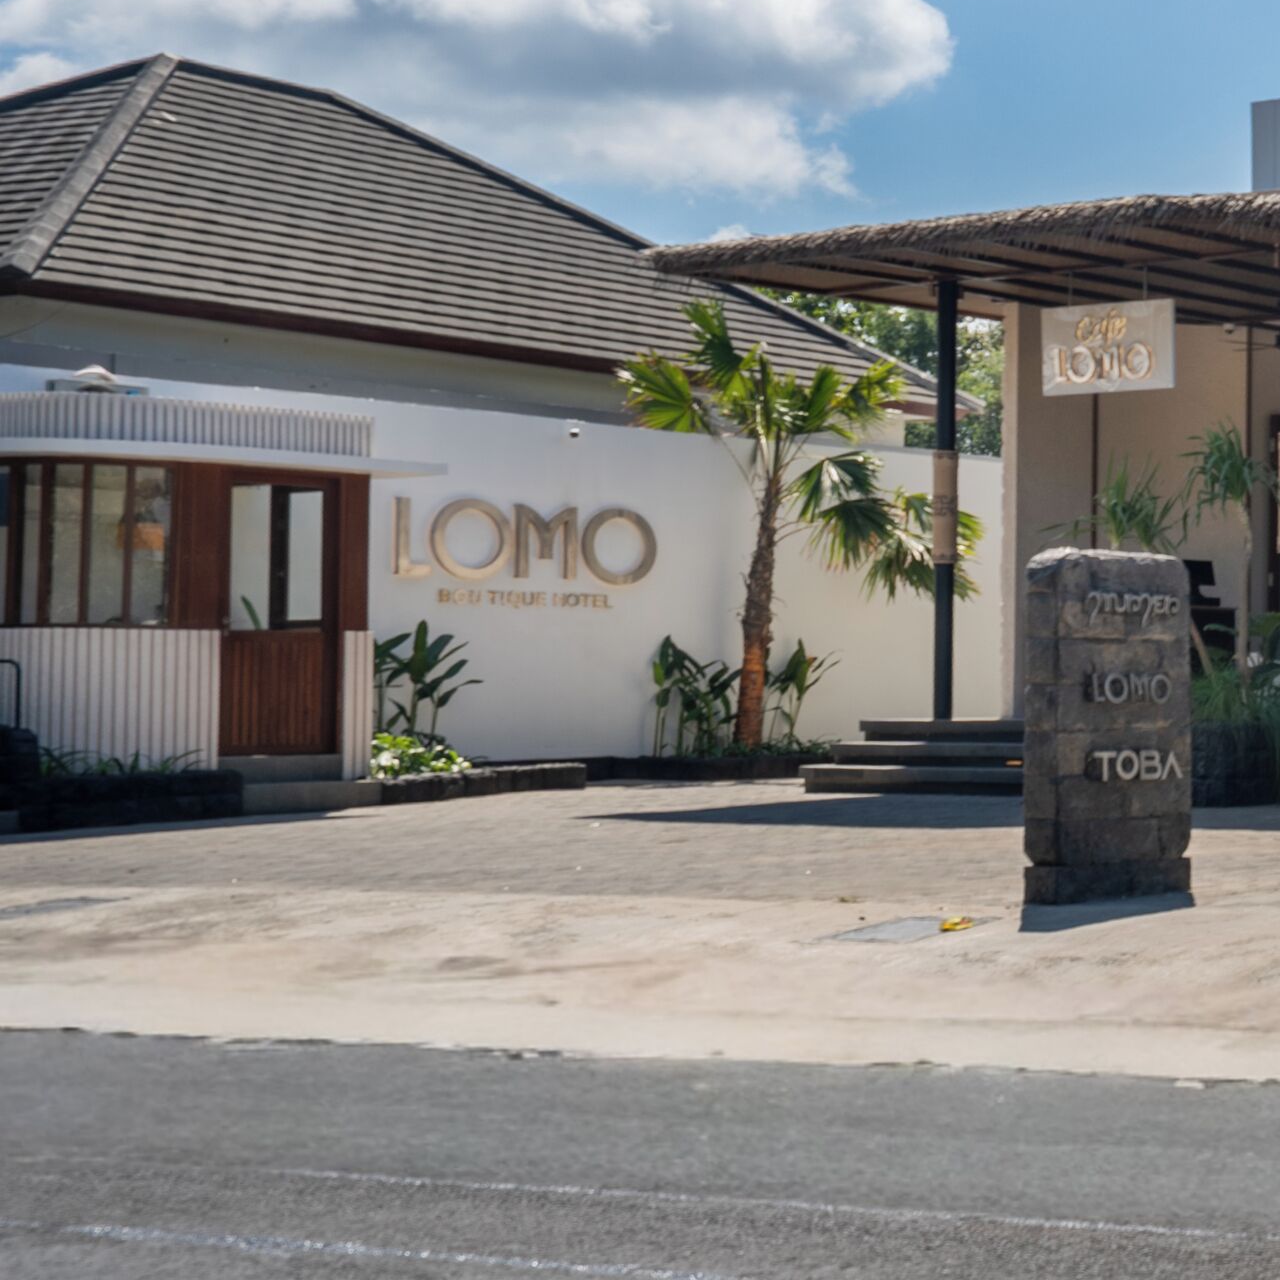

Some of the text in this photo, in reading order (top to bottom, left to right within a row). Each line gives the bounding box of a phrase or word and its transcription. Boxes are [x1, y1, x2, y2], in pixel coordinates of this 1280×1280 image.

[392, 495, 658, 586] LOMO
[437, 588, 613, 609] BOUTIQUE HOTEL
[1092, 671, 1173, 704] LOMO
[1094, 749, 1183, 782] TOBA
